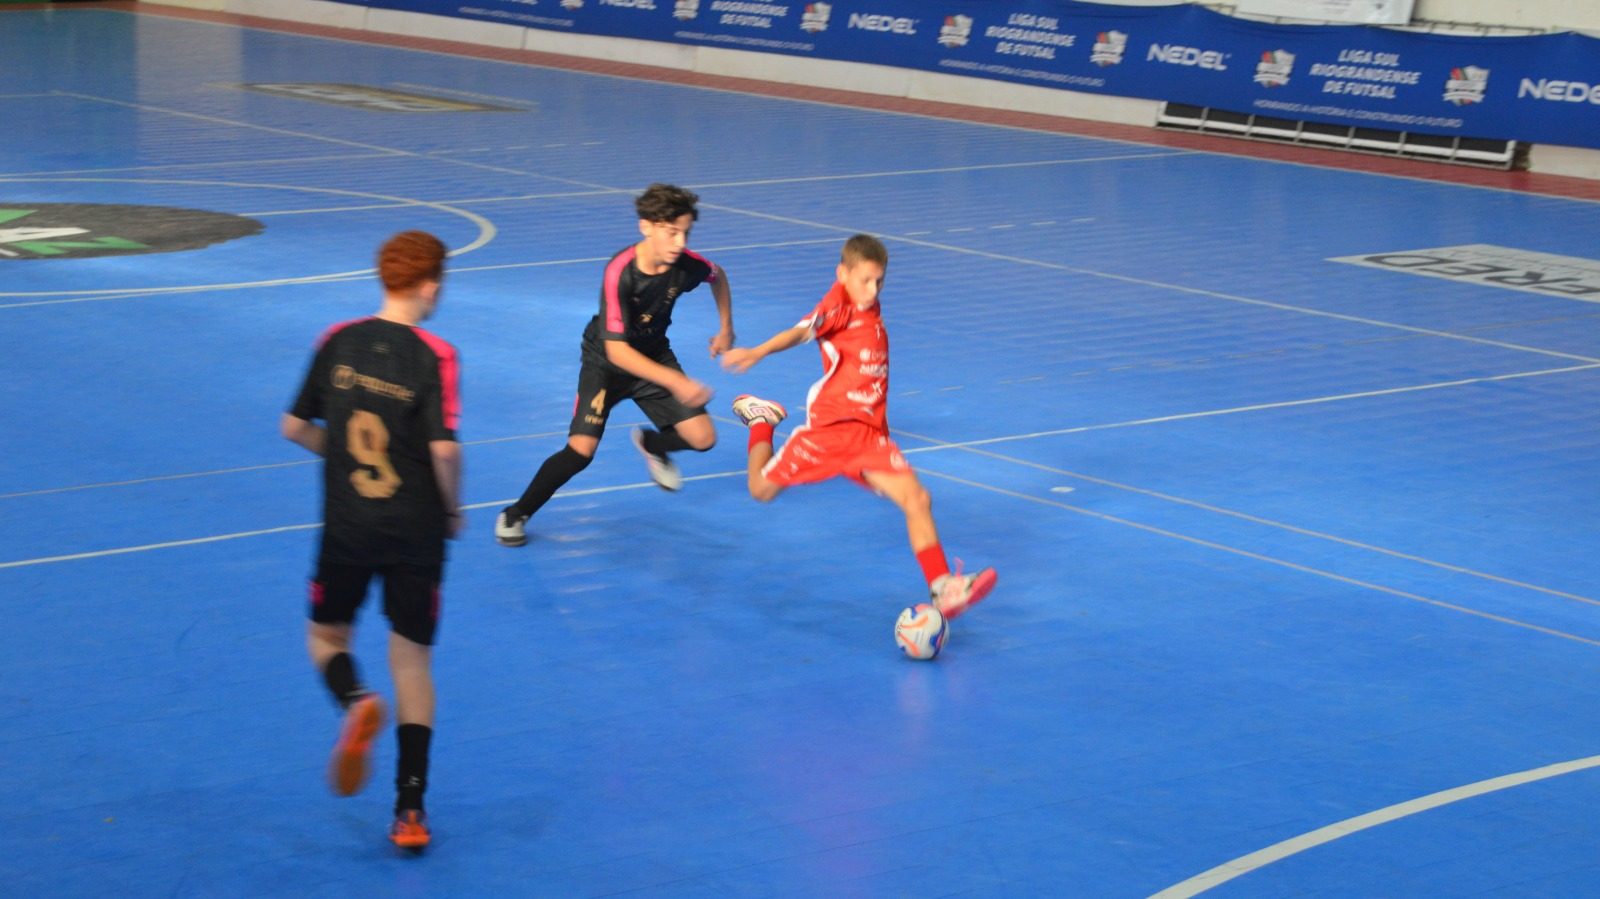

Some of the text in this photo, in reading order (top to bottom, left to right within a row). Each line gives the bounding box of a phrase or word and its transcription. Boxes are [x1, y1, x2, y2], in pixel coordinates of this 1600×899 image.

[848, 13, 917, 35] NEDEL
[1008, 13, 1059, 30] LIGA SUL
[984, 25, 1077, 47] RIOGRANDENSE
[995, 41, 1056, 60] DE FUTSAL
[1146, 43, 1228, 71] NEDEL
[1338, 49, 1399, 67] LIGA SUL
[1308, 63, 1422, 85] RIOGRANDENSE
[1322, 80, 1396, 99] DE FUTSAL
[590, 388, 607, 416] 4
[346, 409, 403, 498] 9
